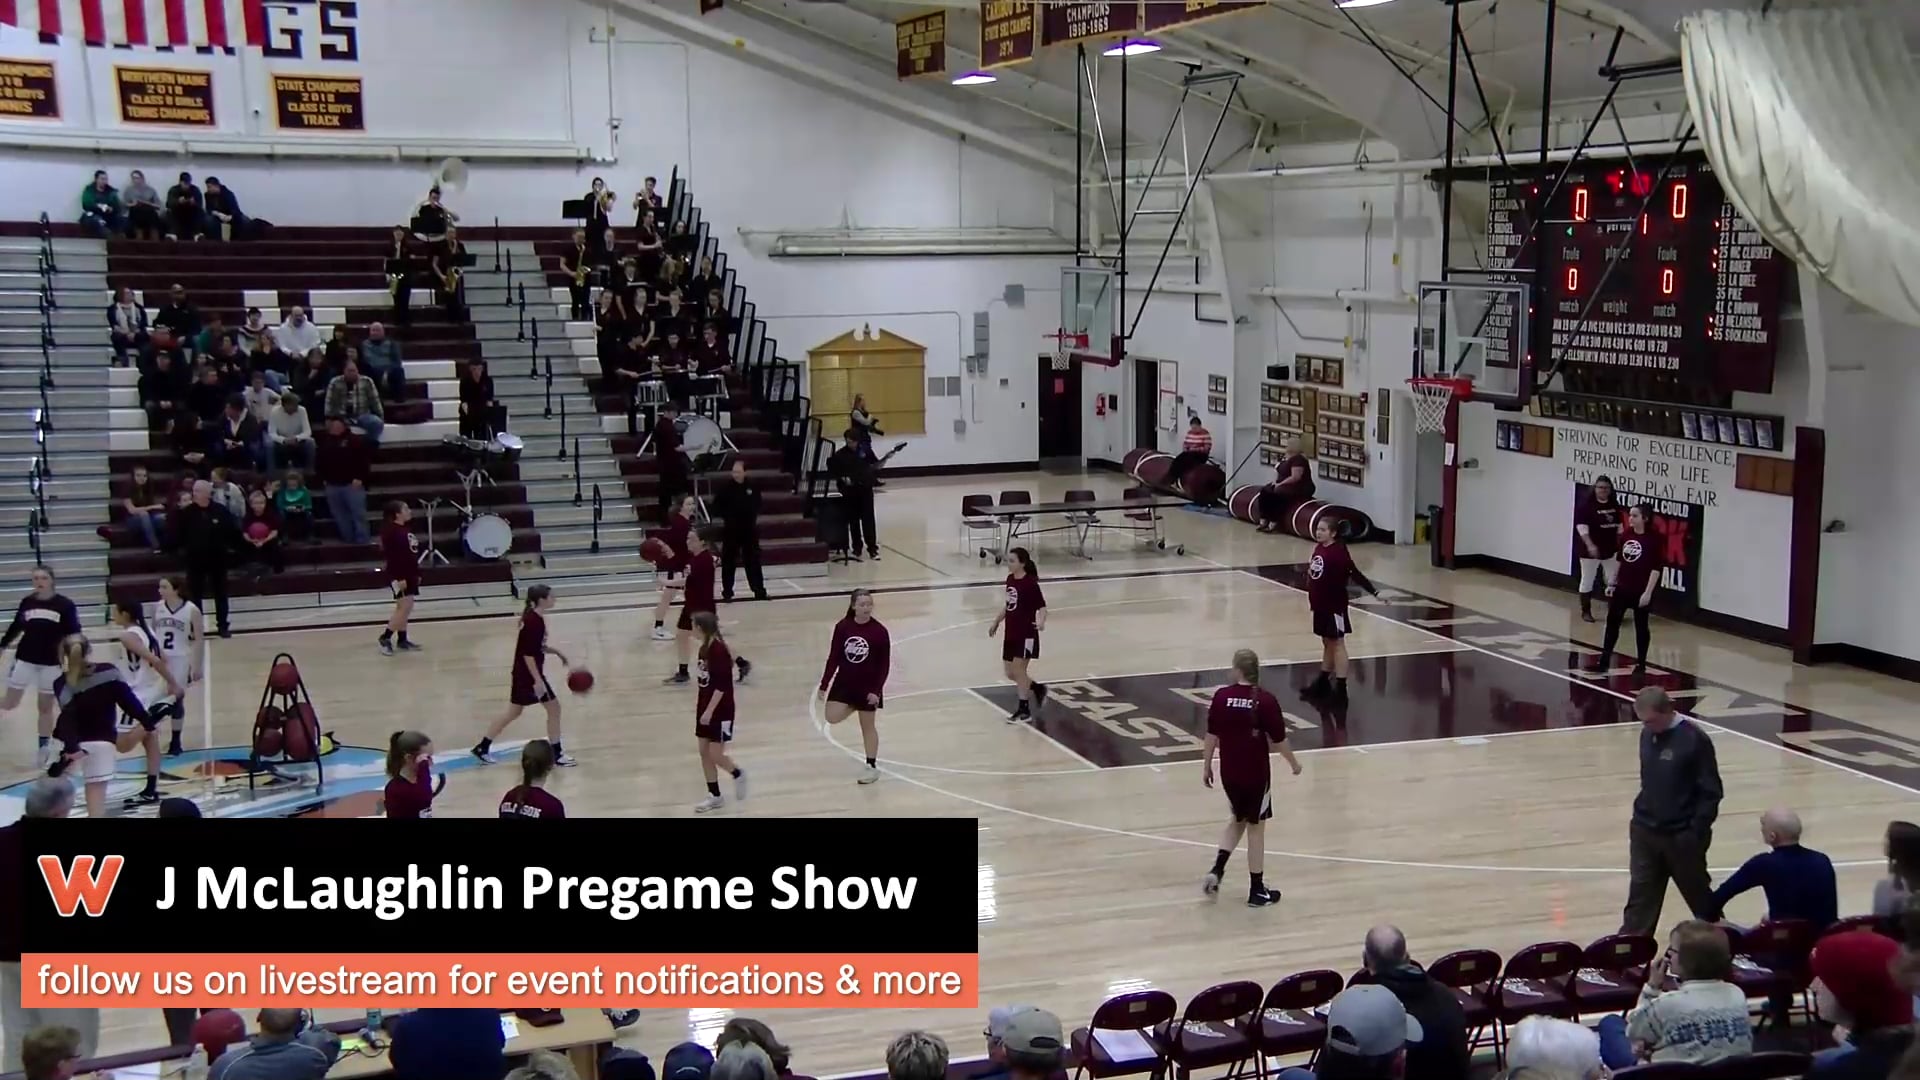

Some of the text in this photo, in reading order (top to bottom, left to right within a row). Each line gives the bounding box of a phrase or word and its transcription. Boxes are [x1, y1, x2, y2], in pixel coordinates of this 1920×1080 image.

[1067, 3, 1110, 23] CHAMPIONS
[1010, 16, 1031, 35] CHAMPS
[121, 71, 208, 86] NORTHERN MAINE
[147, 85, 183, 95] 2018
[277, 80, 360, 93] STATE CHAMPIONS
[131, 94, 164, 105] CLASS
[301, 93, 335, 102] 2018
[126, 106, 211, 121] TENNIS CHAMPIONS
[287, 102, 318, 113] CLASS
[328, 104, 353, 113] BOYS
[302, 114, 341, 126] TRACK
[1576, 189, 1587, 220] 0
[1673, 184, 1687, 218] 0
[1721, 204, 1732, 217] 13
[1721, 219, 1730, 231] 15
[1720, 232, 1729, 245] 23
[1719, 245, 1728, 258] 25
[1718, 260, 1727, 272] 31
[1568, 268, 1578, 291] 0
[1663, 269, 1673, 294] 0
[1717, 274, 1726, 286] 33
[1716, 287, 1725, 300] 35
[1603, 301, 1628, 316] weight
[1715, 301, 1724, 313] 41
[1714, 315, 1724, 327] 43
[1713, 328, 1723, 340] 55
[1557, 427, 1736, 468] STRIVING FOR EXCELLENCE,
[1574, 449, 1637, 472] PREPARING
[1646, 460, 1669, 477] FOR
[1566, 466, 1593, 483] PLAY
[1604, 473, 1636, 494] ARD
[1645, 480, 1677, 499] PLAY
[1660, 500, 1690, 518] COULD
[1660, 566, 1686, 593] ALL
[163, 631, 175, 650] 2
[1226, 697, 1259, 709] PEIRC
[1048, 680, 1206, 756] EAST
